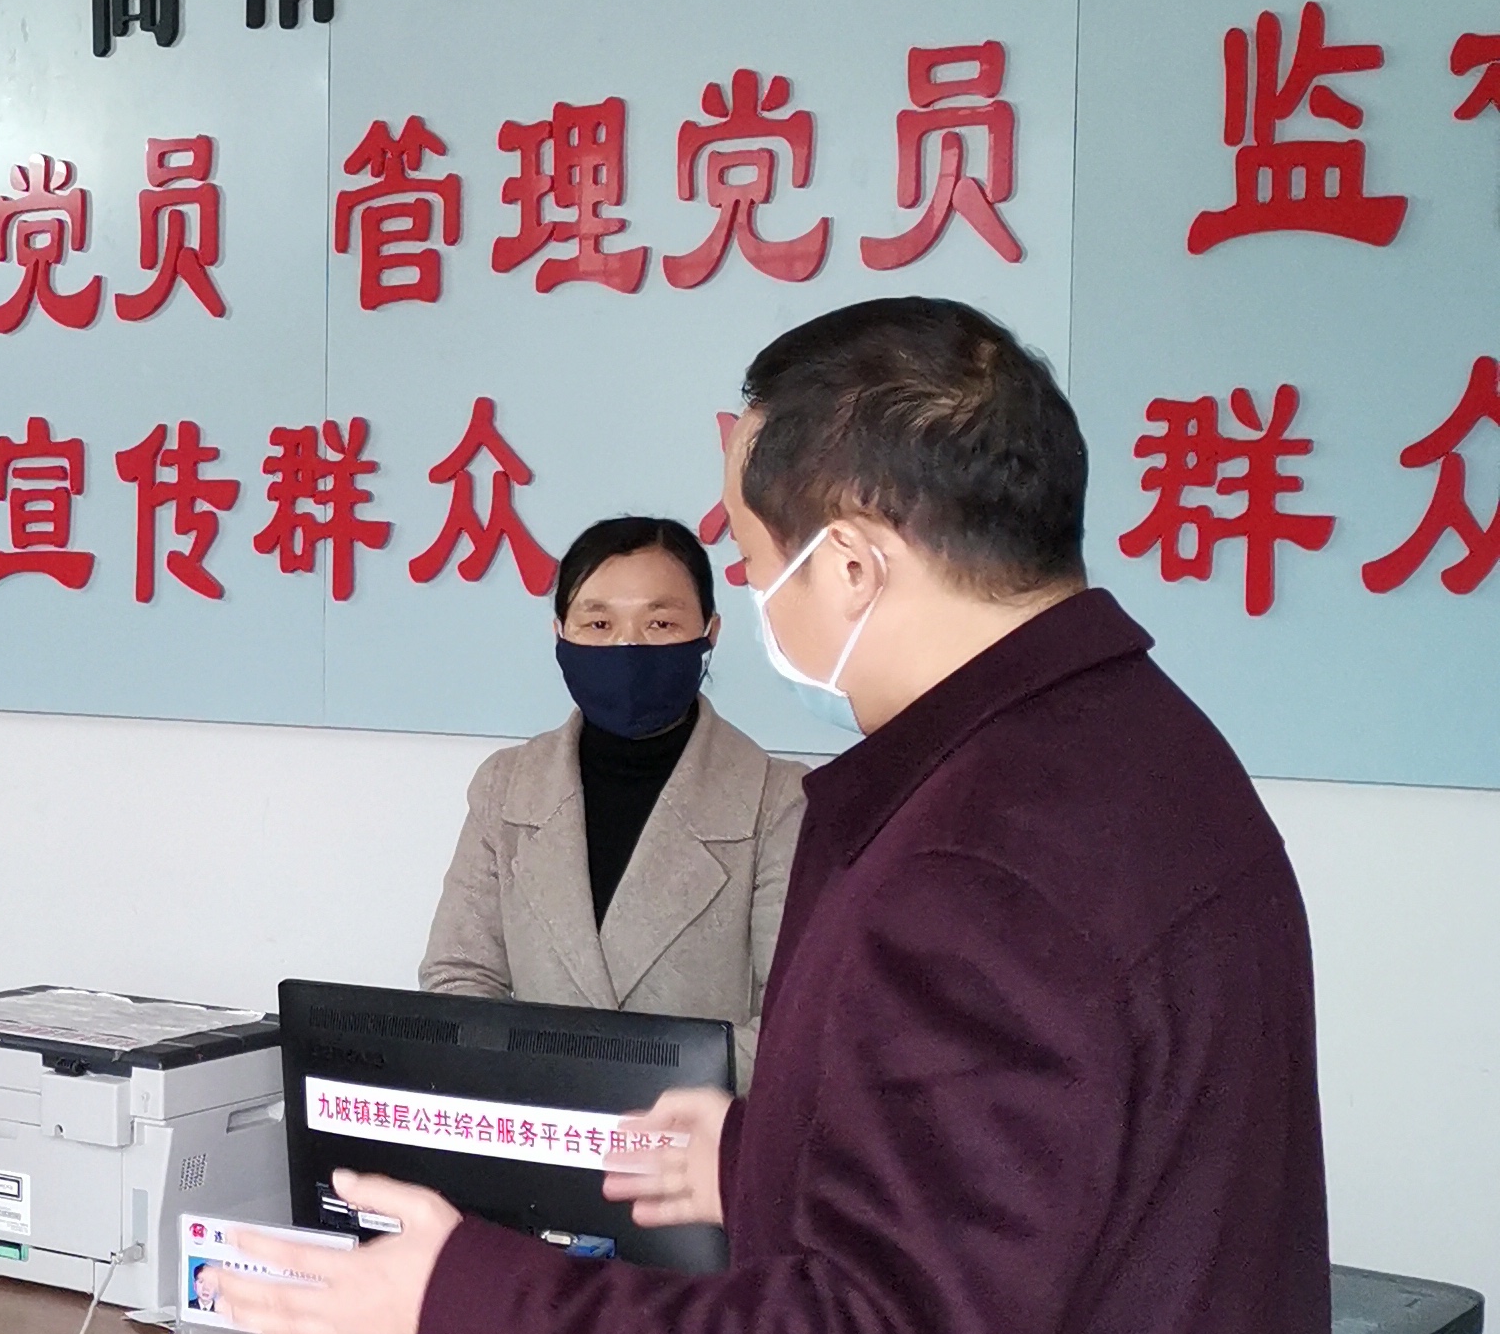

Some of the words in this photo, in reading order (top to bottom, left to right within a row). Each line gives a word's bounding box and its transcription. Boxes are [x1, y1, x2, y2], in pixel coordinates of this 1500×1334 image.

[334, 41, 1023, 312] 管理党员
[1187, 2, 1500, 255] 监
